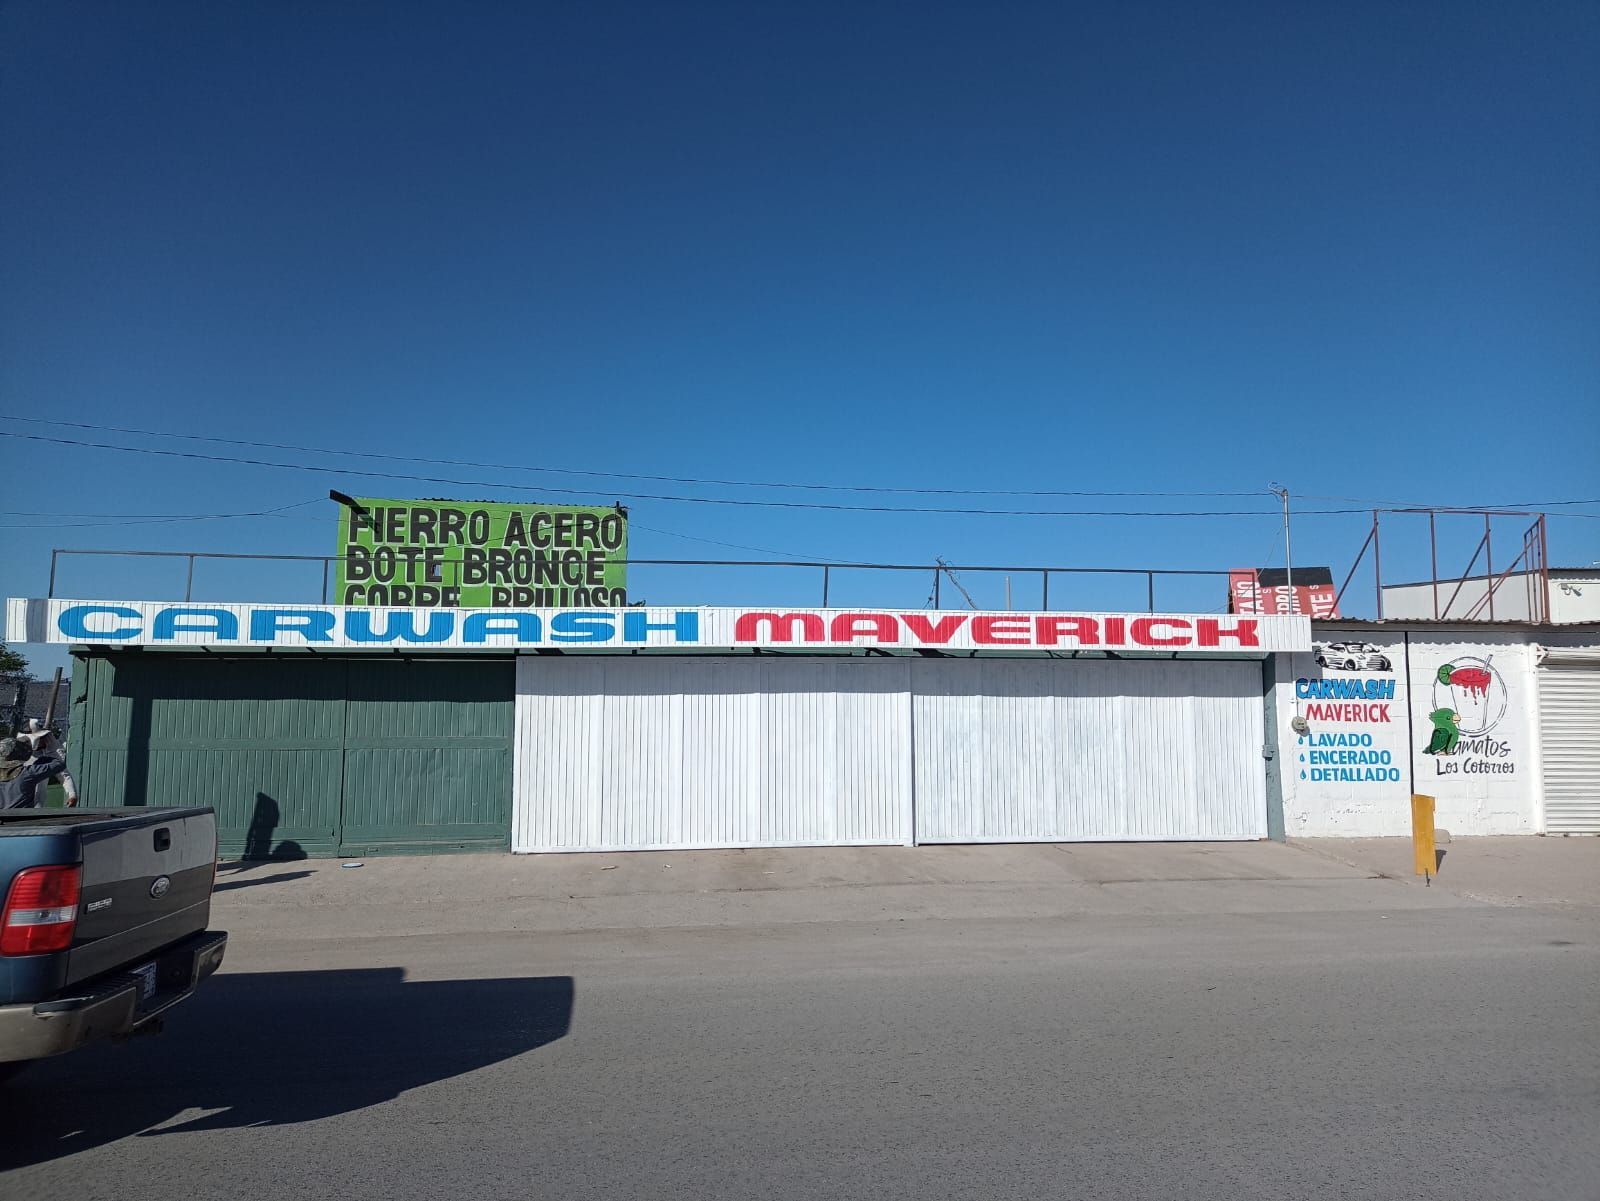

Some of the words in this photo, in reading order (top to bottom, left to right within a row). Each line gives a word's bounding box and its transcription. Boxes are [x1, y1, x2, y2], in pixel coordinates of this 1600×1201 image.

[348, 506, 490, 545] FIERRO
[504, 511, 623, 550] ACERO
[346, 546, 444, 584] BOTE
[462, 549, 606, 585] BRONCE
[58, 606, 698, 643] CARWASH
[735, 612, 1259, 647] MAVERICK
[1295, 678, 1395, 700] CARWASH
[1306, 703, 1391, 722] MAVERICK
[1308, 733, 1372, 747] LAVADO
[1309, 750, 1391, 764] ENCERADO
[1436, 758, 1458, 775] Los
[1310, 767, 1400, 782] DETALLADO
